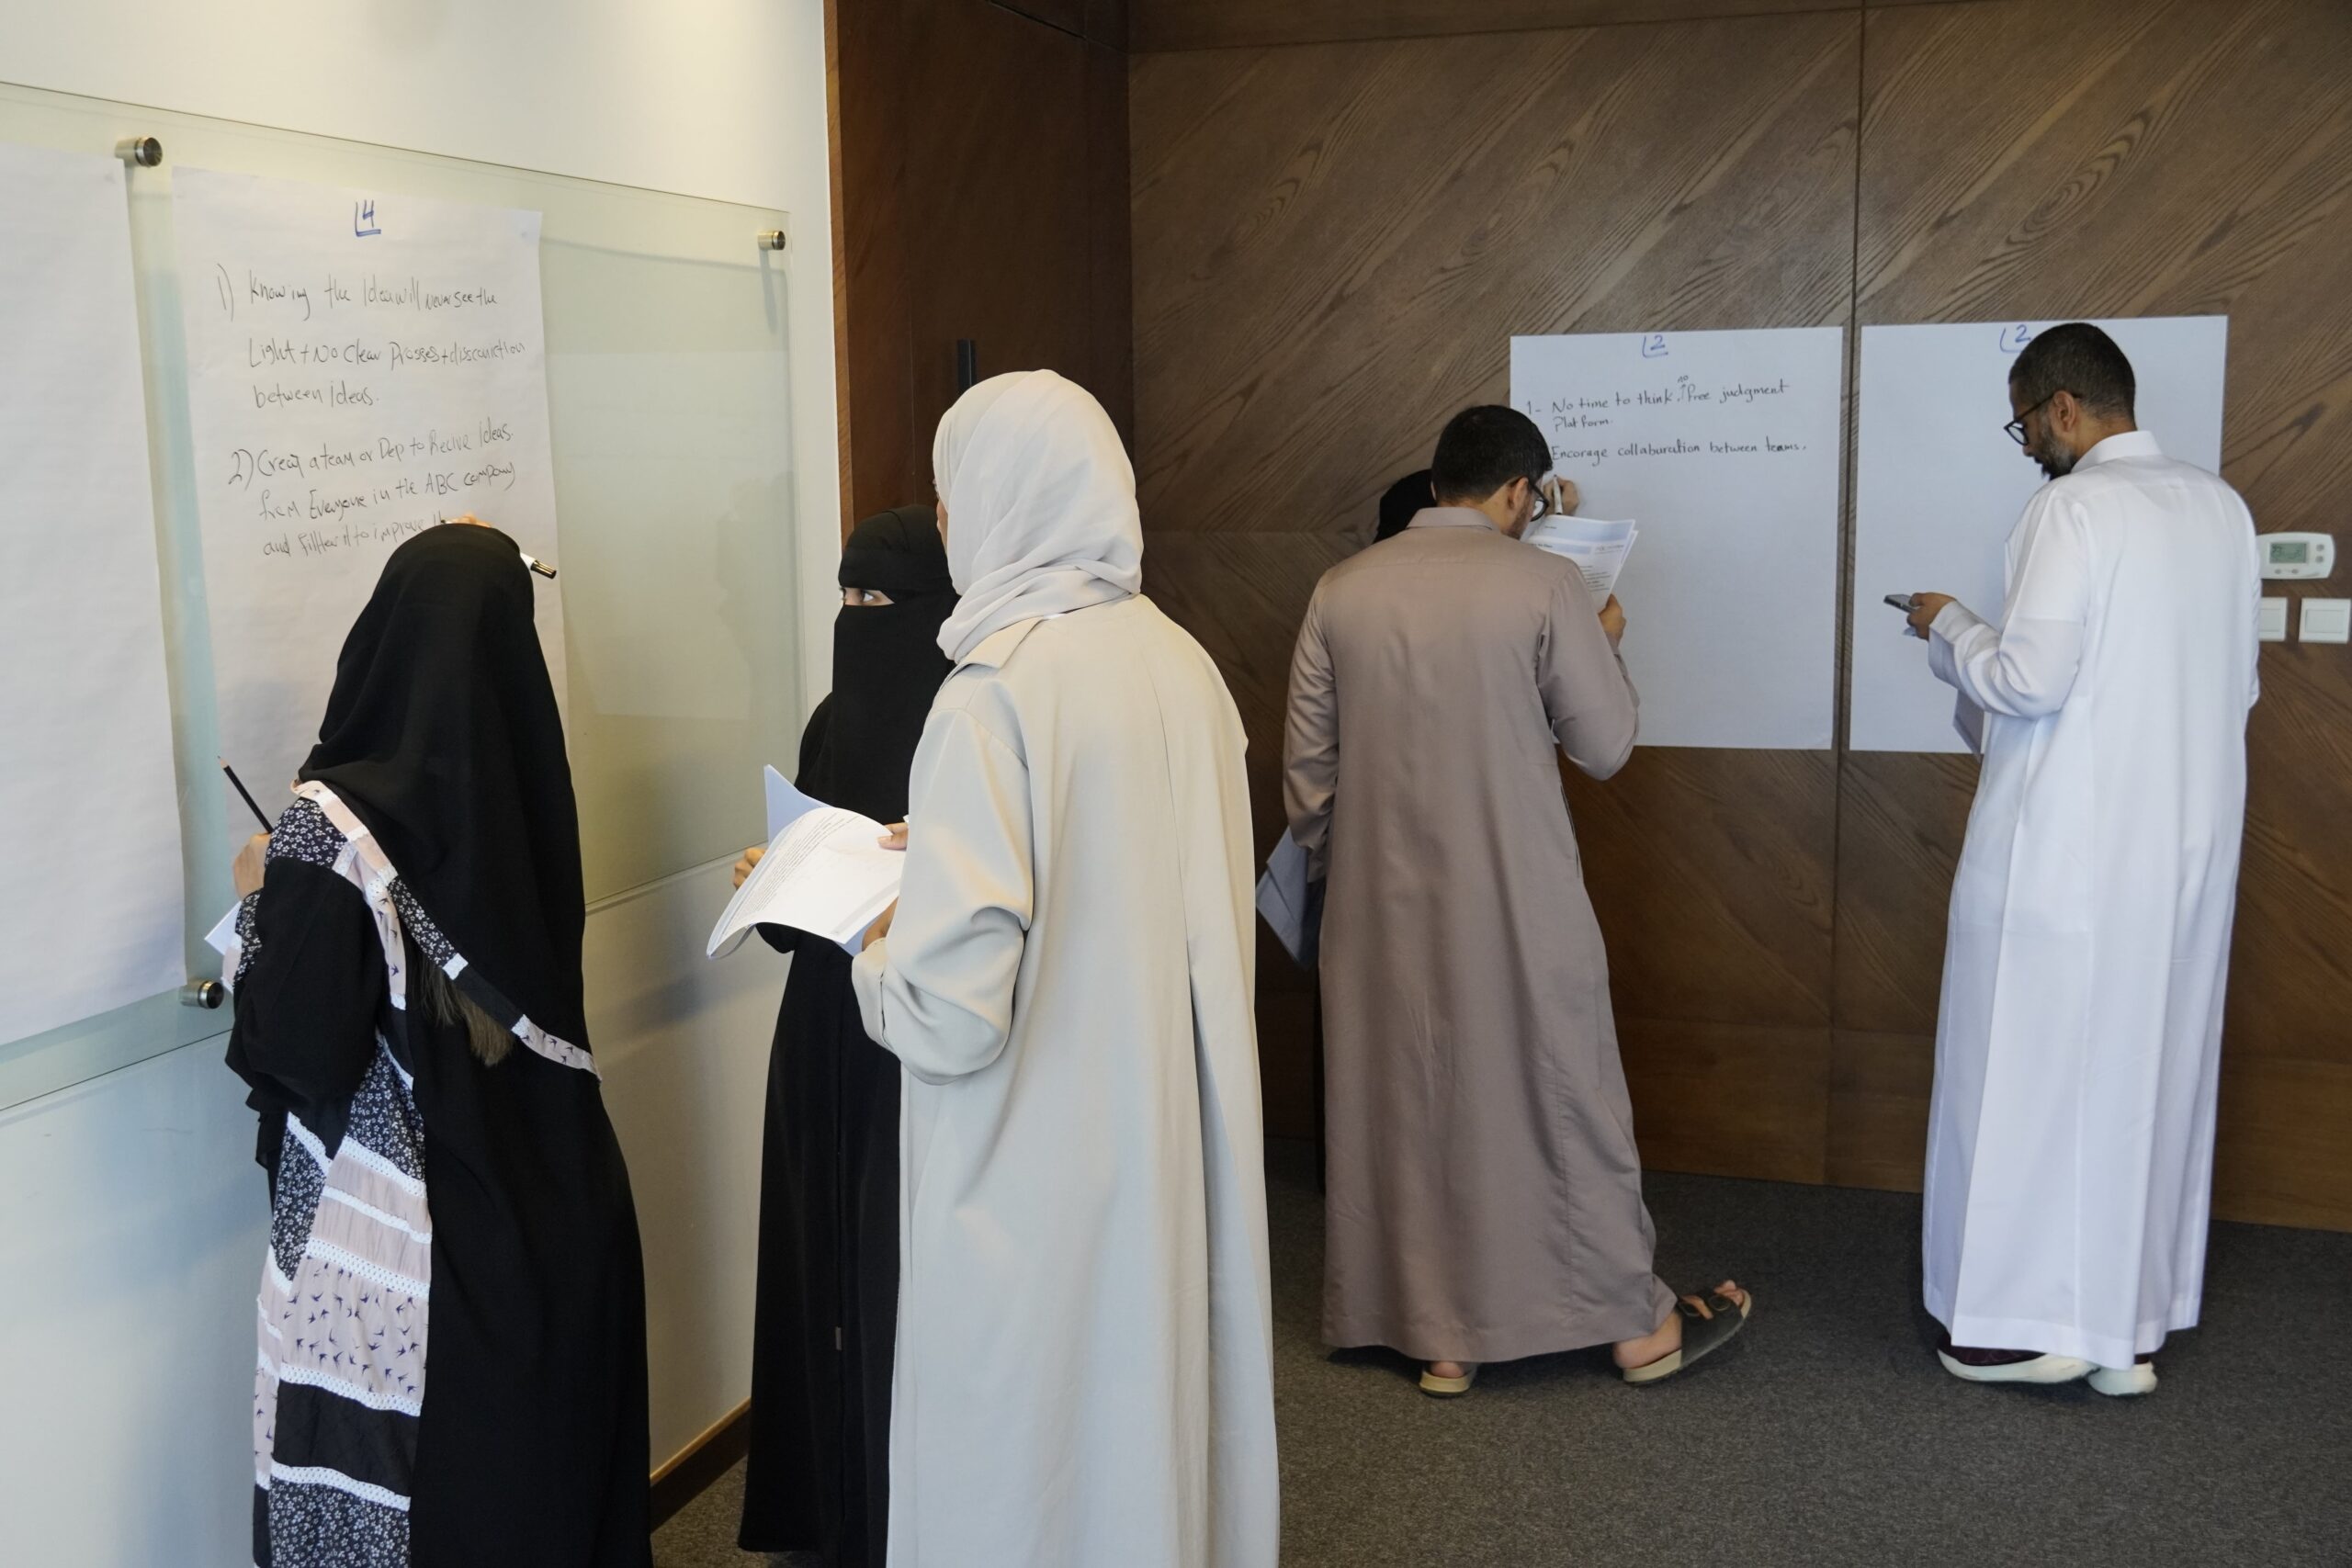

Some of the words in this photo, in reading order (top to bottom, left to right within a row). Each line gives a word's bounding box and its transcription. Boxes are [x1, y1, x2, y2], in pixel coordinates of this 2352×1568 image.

[253, 382, 323, 409] between
[1552, 398, 1574, 413] No
[1578, 398, 1609, 410] time
[1615, 391, 1631, 407] to
[1719, 378, 1791, 404] judgment
[309, 457, 320, 471] a
[359, 450, 373, 462] or
[409, 437, 425, 457] to
[1710, 441, 1758, 454] between
[372, 489, 391, 505] in
[395, 478, 418, 500] the
[425, 472, 459, 496] ABC
[263, 533, 291, 558] and
[354, 524, 369, 547] to
